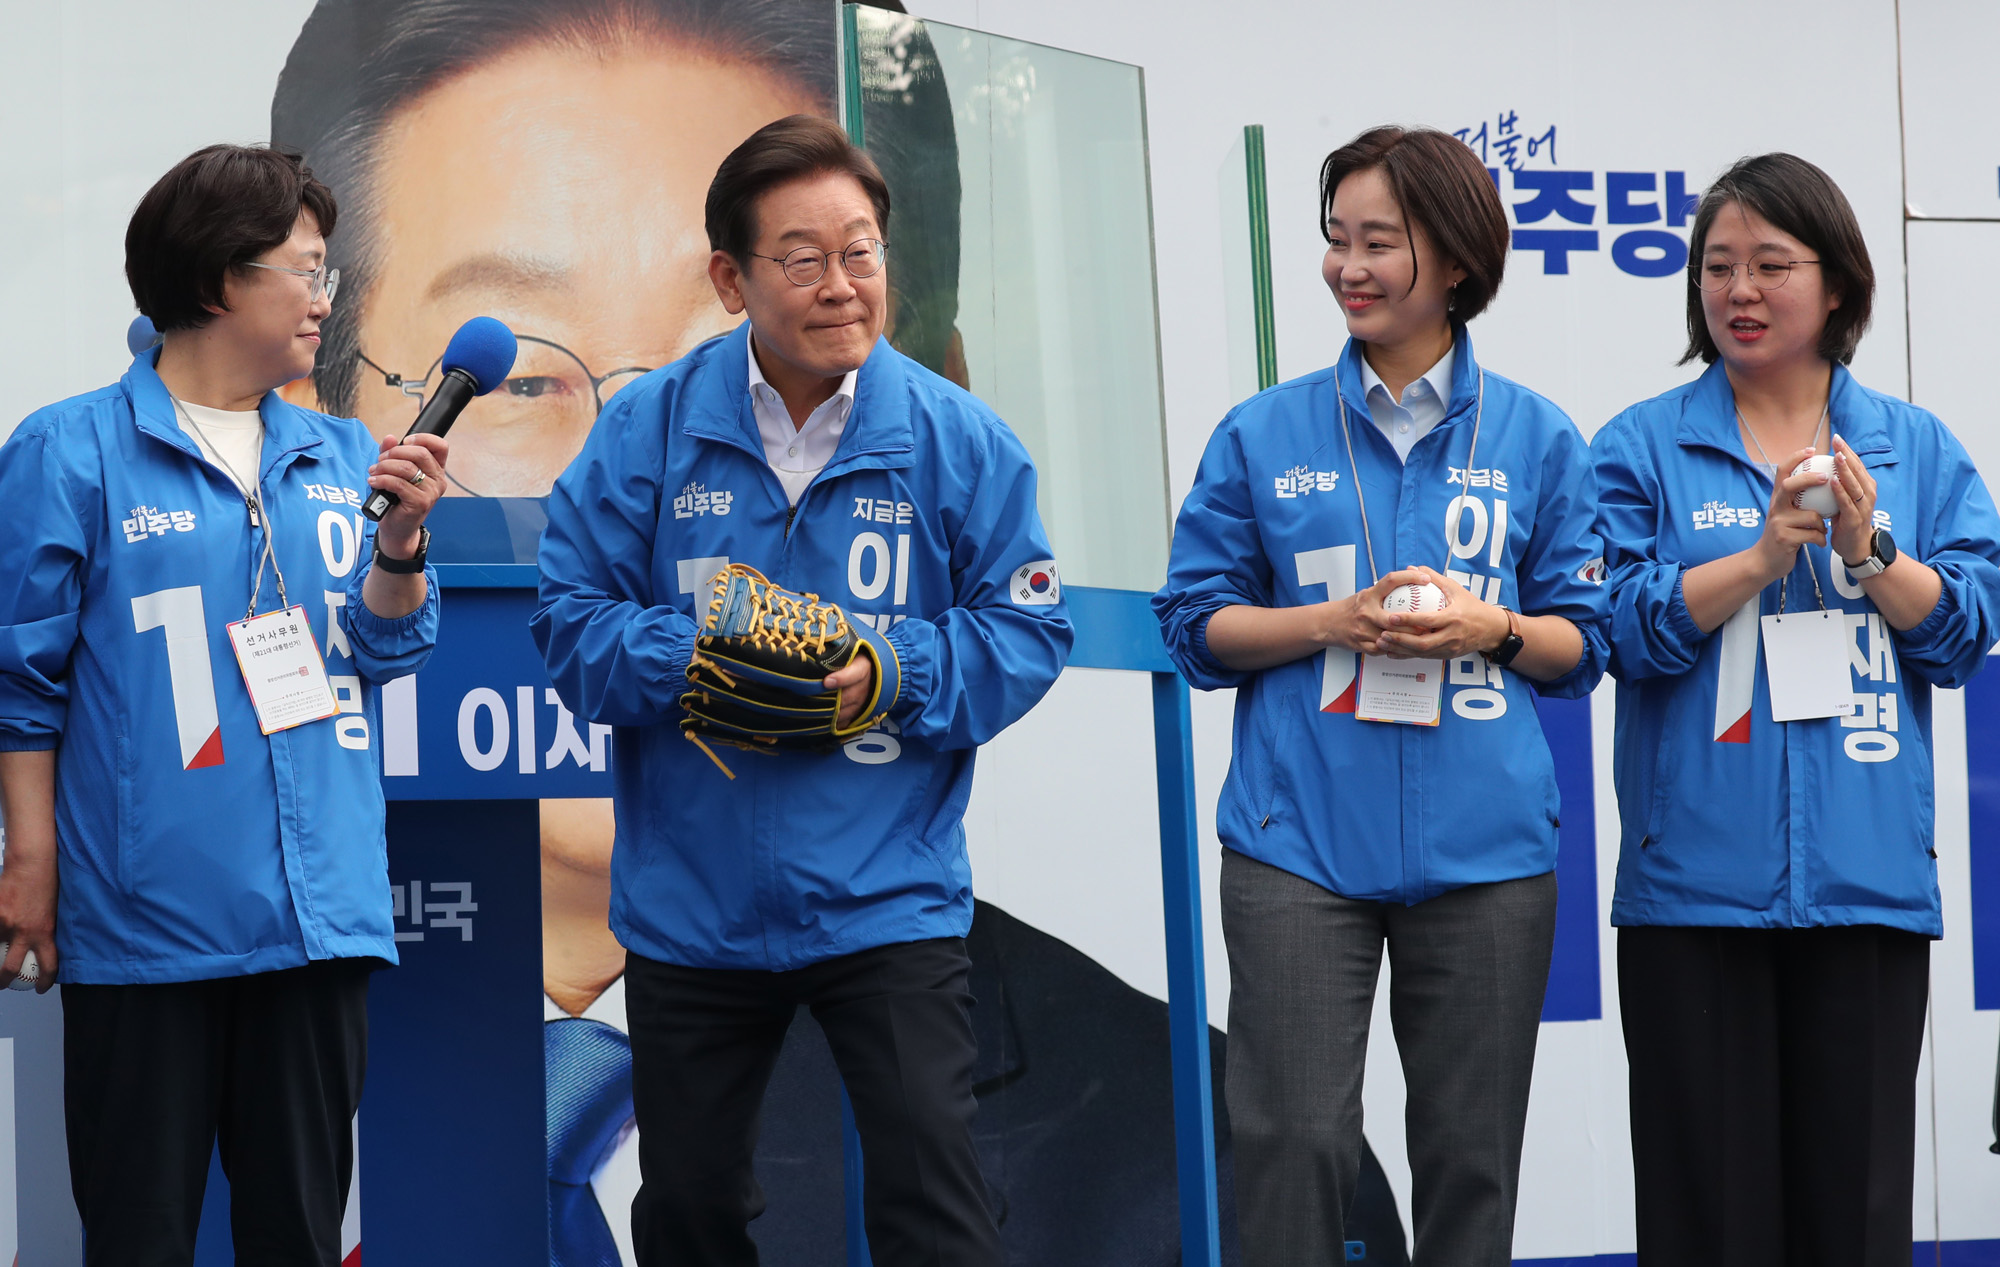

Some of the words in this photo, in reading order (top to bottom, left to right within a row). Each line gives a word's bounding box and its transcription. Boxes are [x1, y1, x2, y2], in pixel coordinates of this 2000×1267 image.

[1452, 110, 1557, 172] 더불어
[1485, 168, 1700, 278] 주당
[1274, 470, 1340, 498] 민주당
[1447, 466, 1509, 492] 지금은
[303, 483, 361, 507] 지금은
[673, 491, 734, 520] 민주당
[852, 497, 914, 525] 지금은
[1692, 507, 1761, 531] 민주당
[122, 510, 196, 544] 민주당
[246, 624, 299, 646] 선거사무원
[1294, 544, 1356, 713] 1
[130, 585, 225, 771] 1
